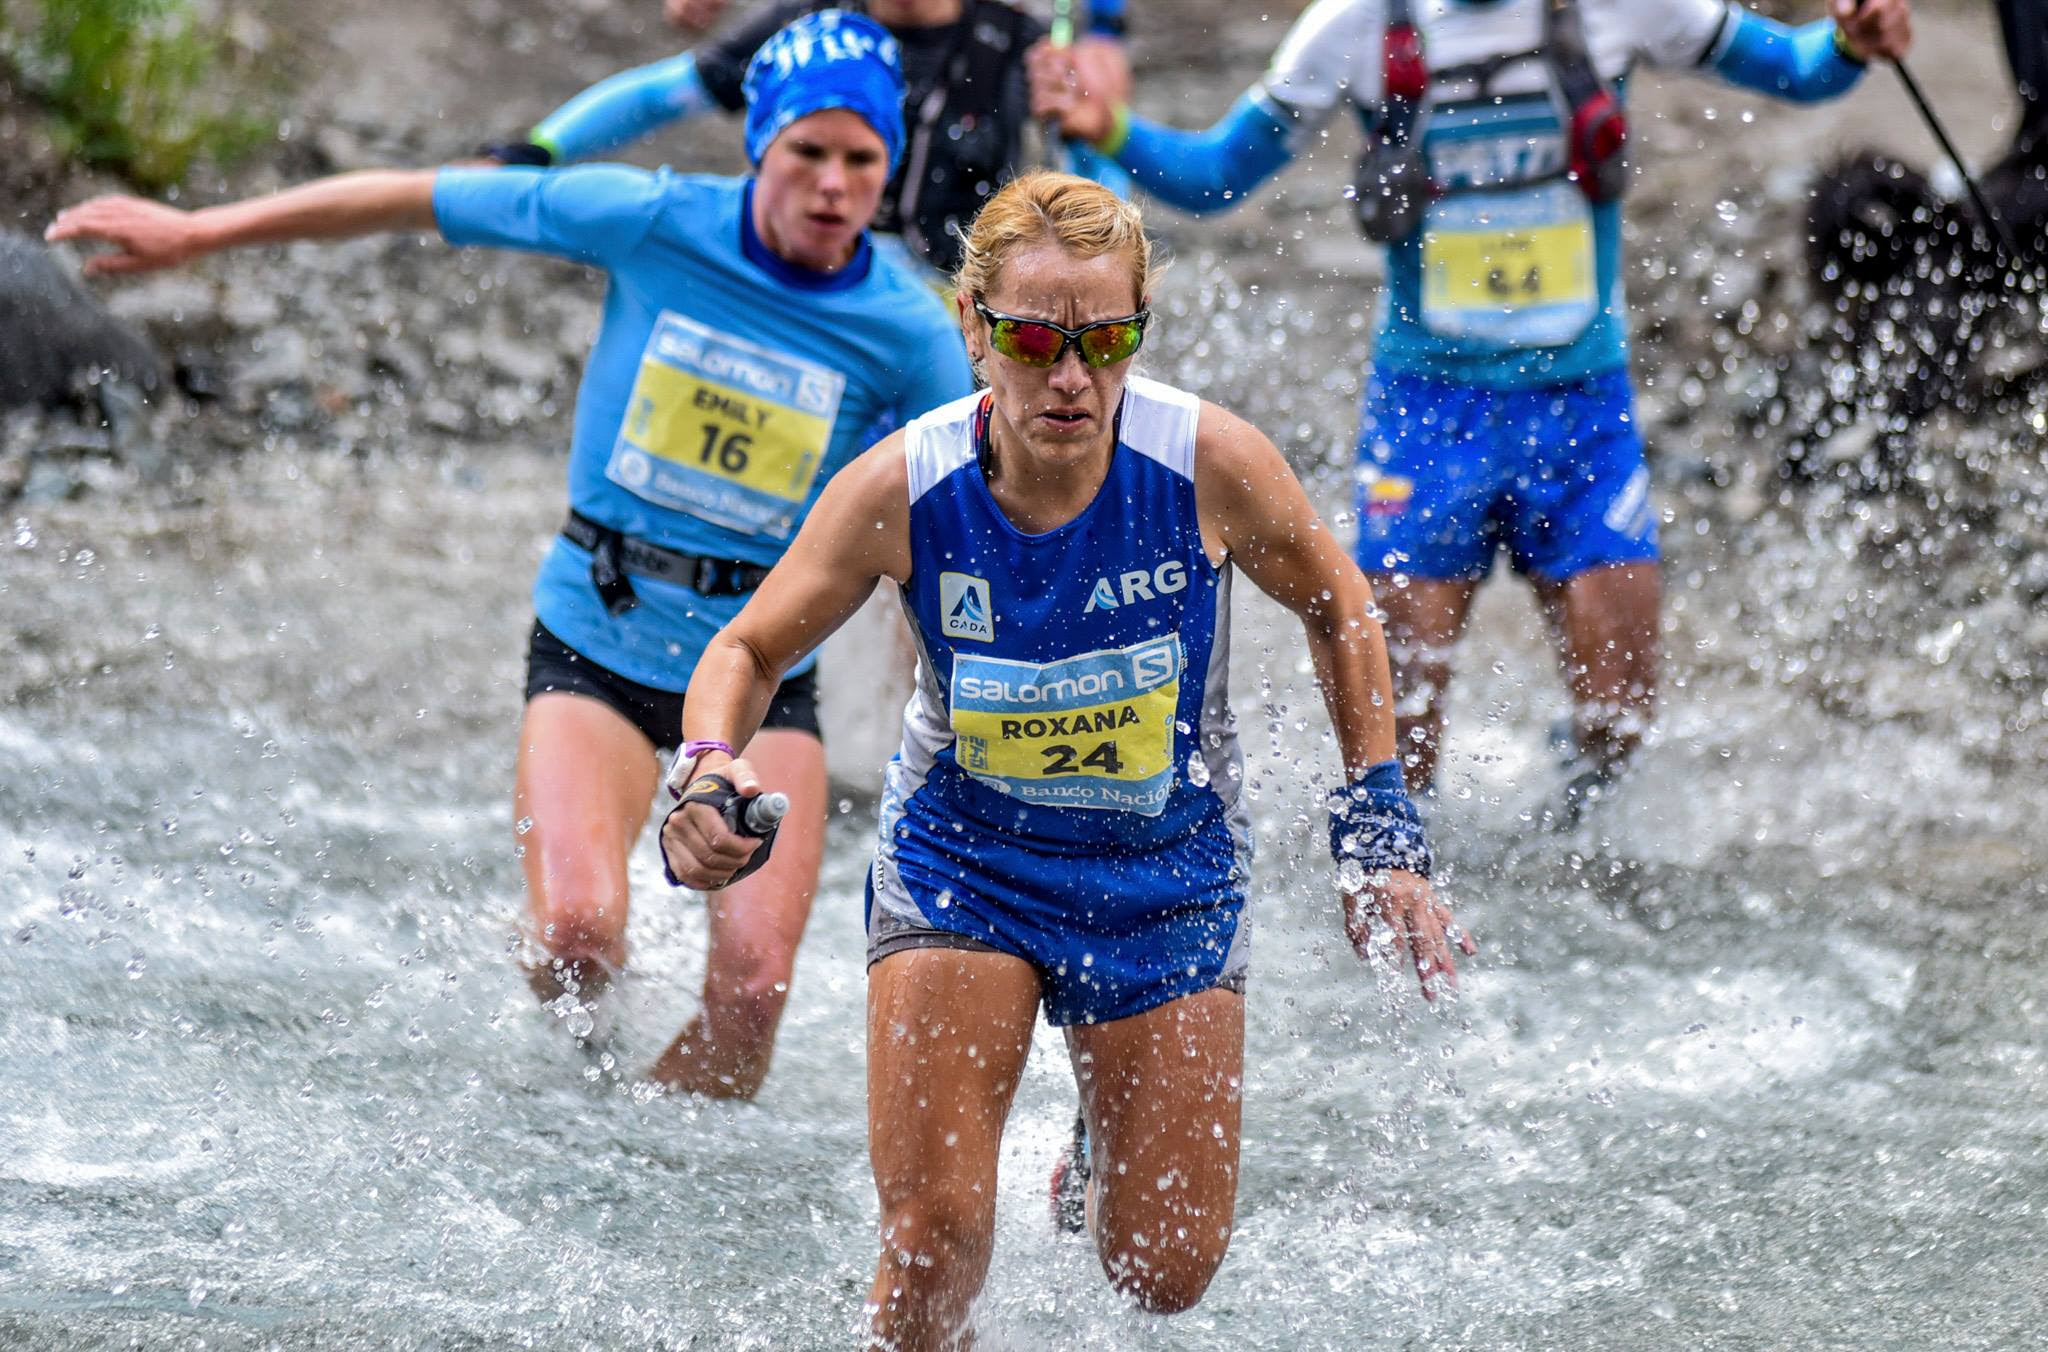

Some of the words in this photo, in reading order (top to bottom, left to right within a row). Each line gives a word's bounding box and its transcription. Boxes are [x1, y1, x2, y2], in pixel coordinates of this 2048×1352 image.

[693, 388, 773, 430] EMILY
[699, 423, 754, 475] 16
[1084, 560, 1189, 613] ARG
[949, 619, 988, 635] CADA
[959, 669, 1124, 704] salomon
[1001, 705, 1141, 740] ROXANA
[1041, 740, 1124, 775] 24
[1020, 785, 1096, 799] Banco
